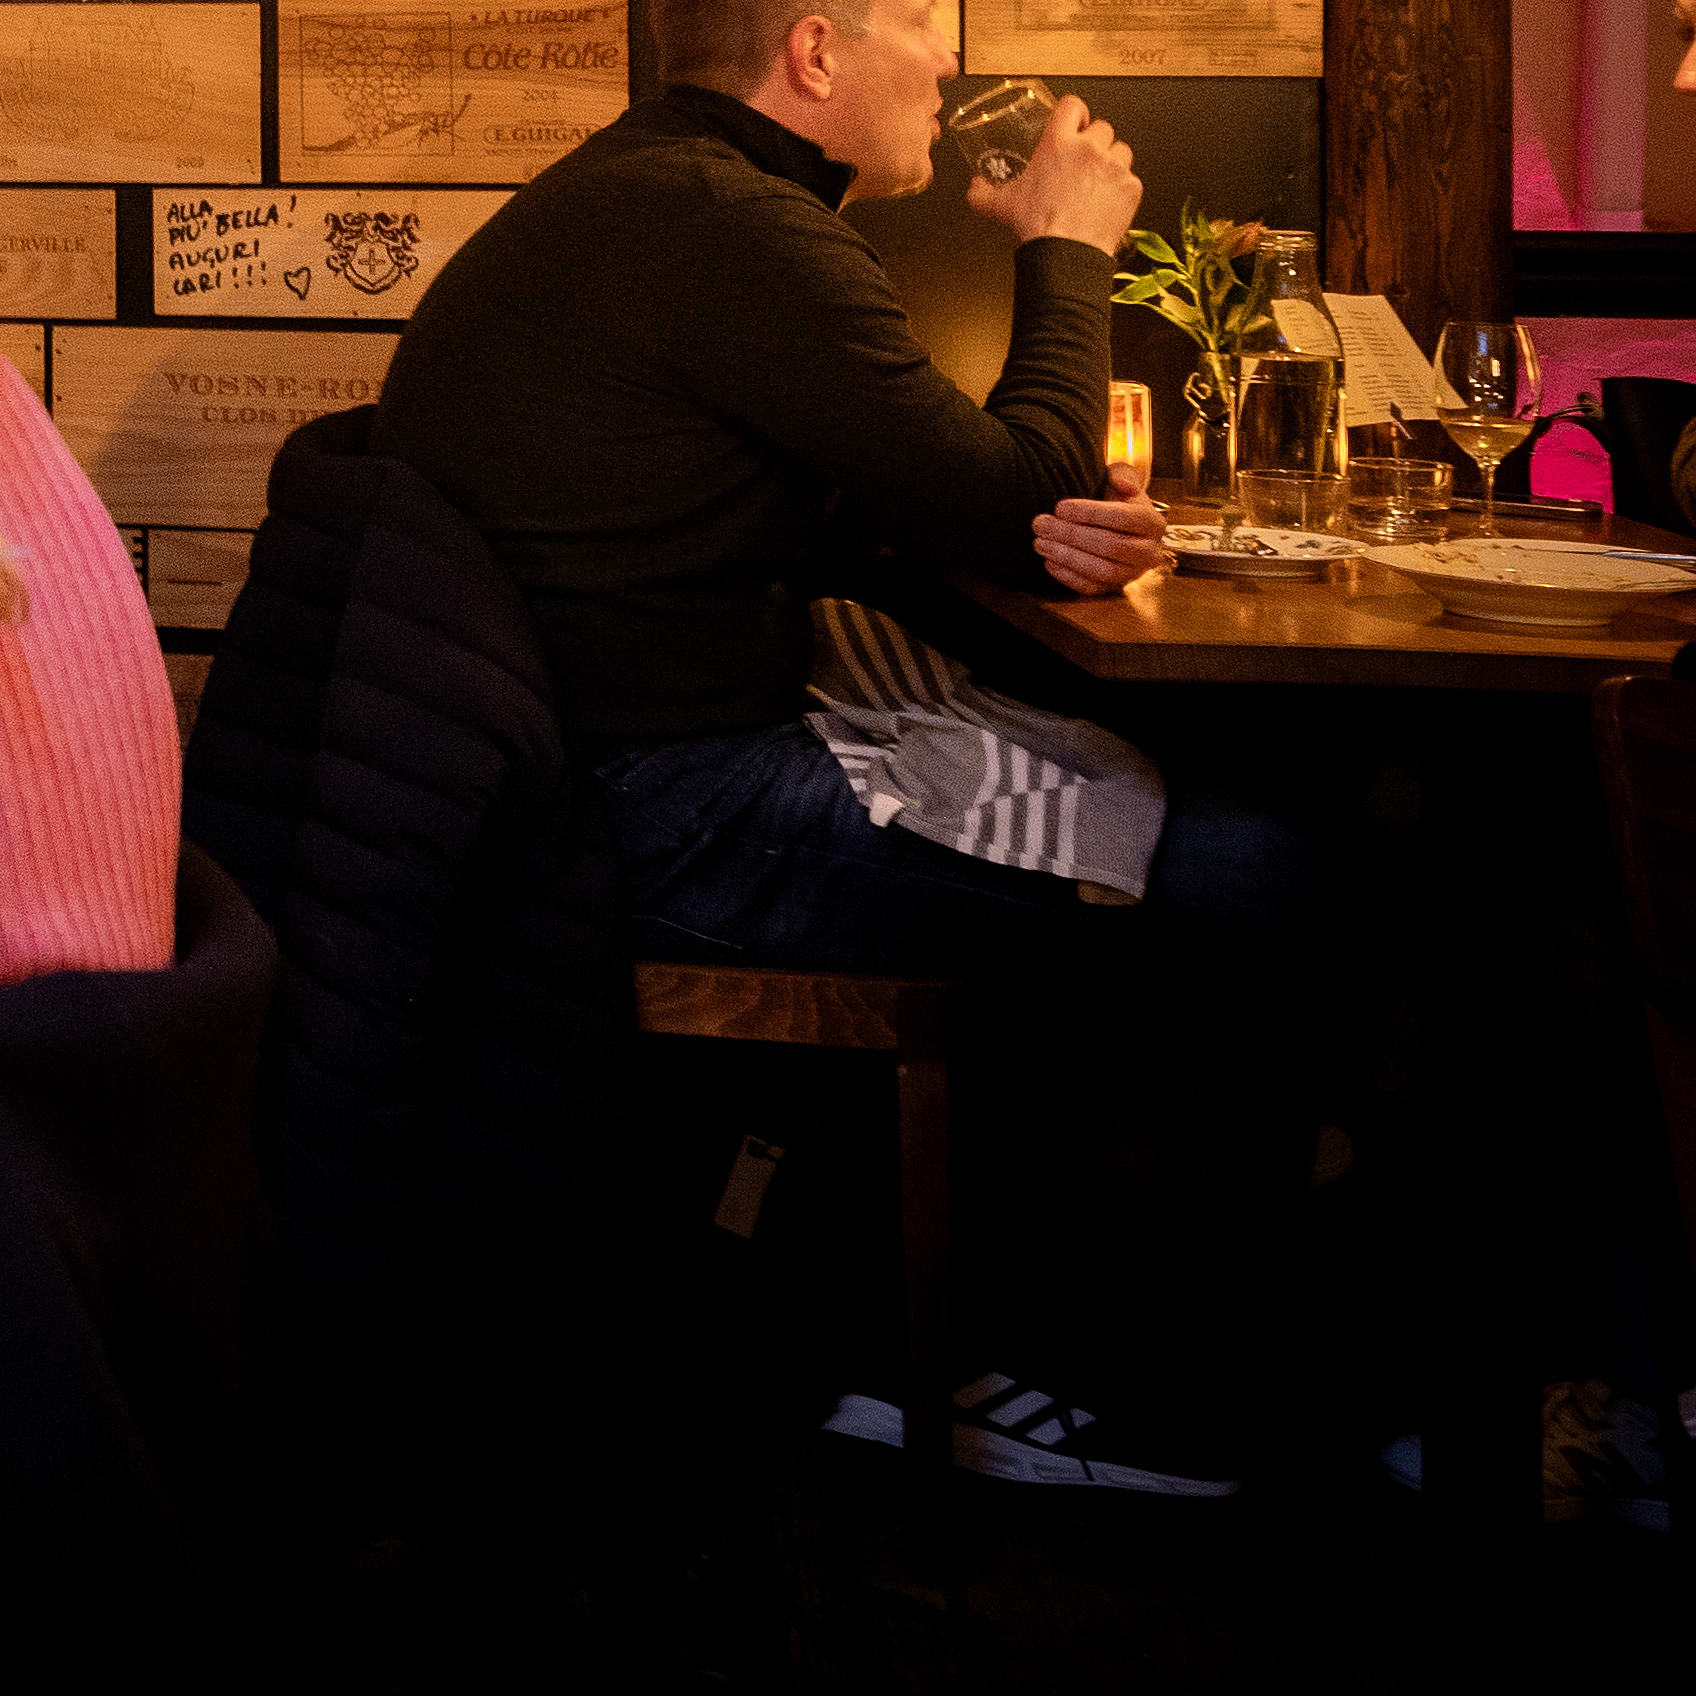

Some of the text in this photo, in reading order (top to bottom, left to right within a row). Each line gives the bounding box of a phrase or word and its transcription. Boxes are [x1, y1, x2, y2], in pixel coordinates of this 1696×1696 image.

[483, 7, 597, 26] LA TURQUE
[167, 199, 213, 224] ALLA
[168, 237, 261, 271] AUGURI
[163, 371, 381, 402] VOSNE-RO
[200, 405, 278, 426] CLOS
